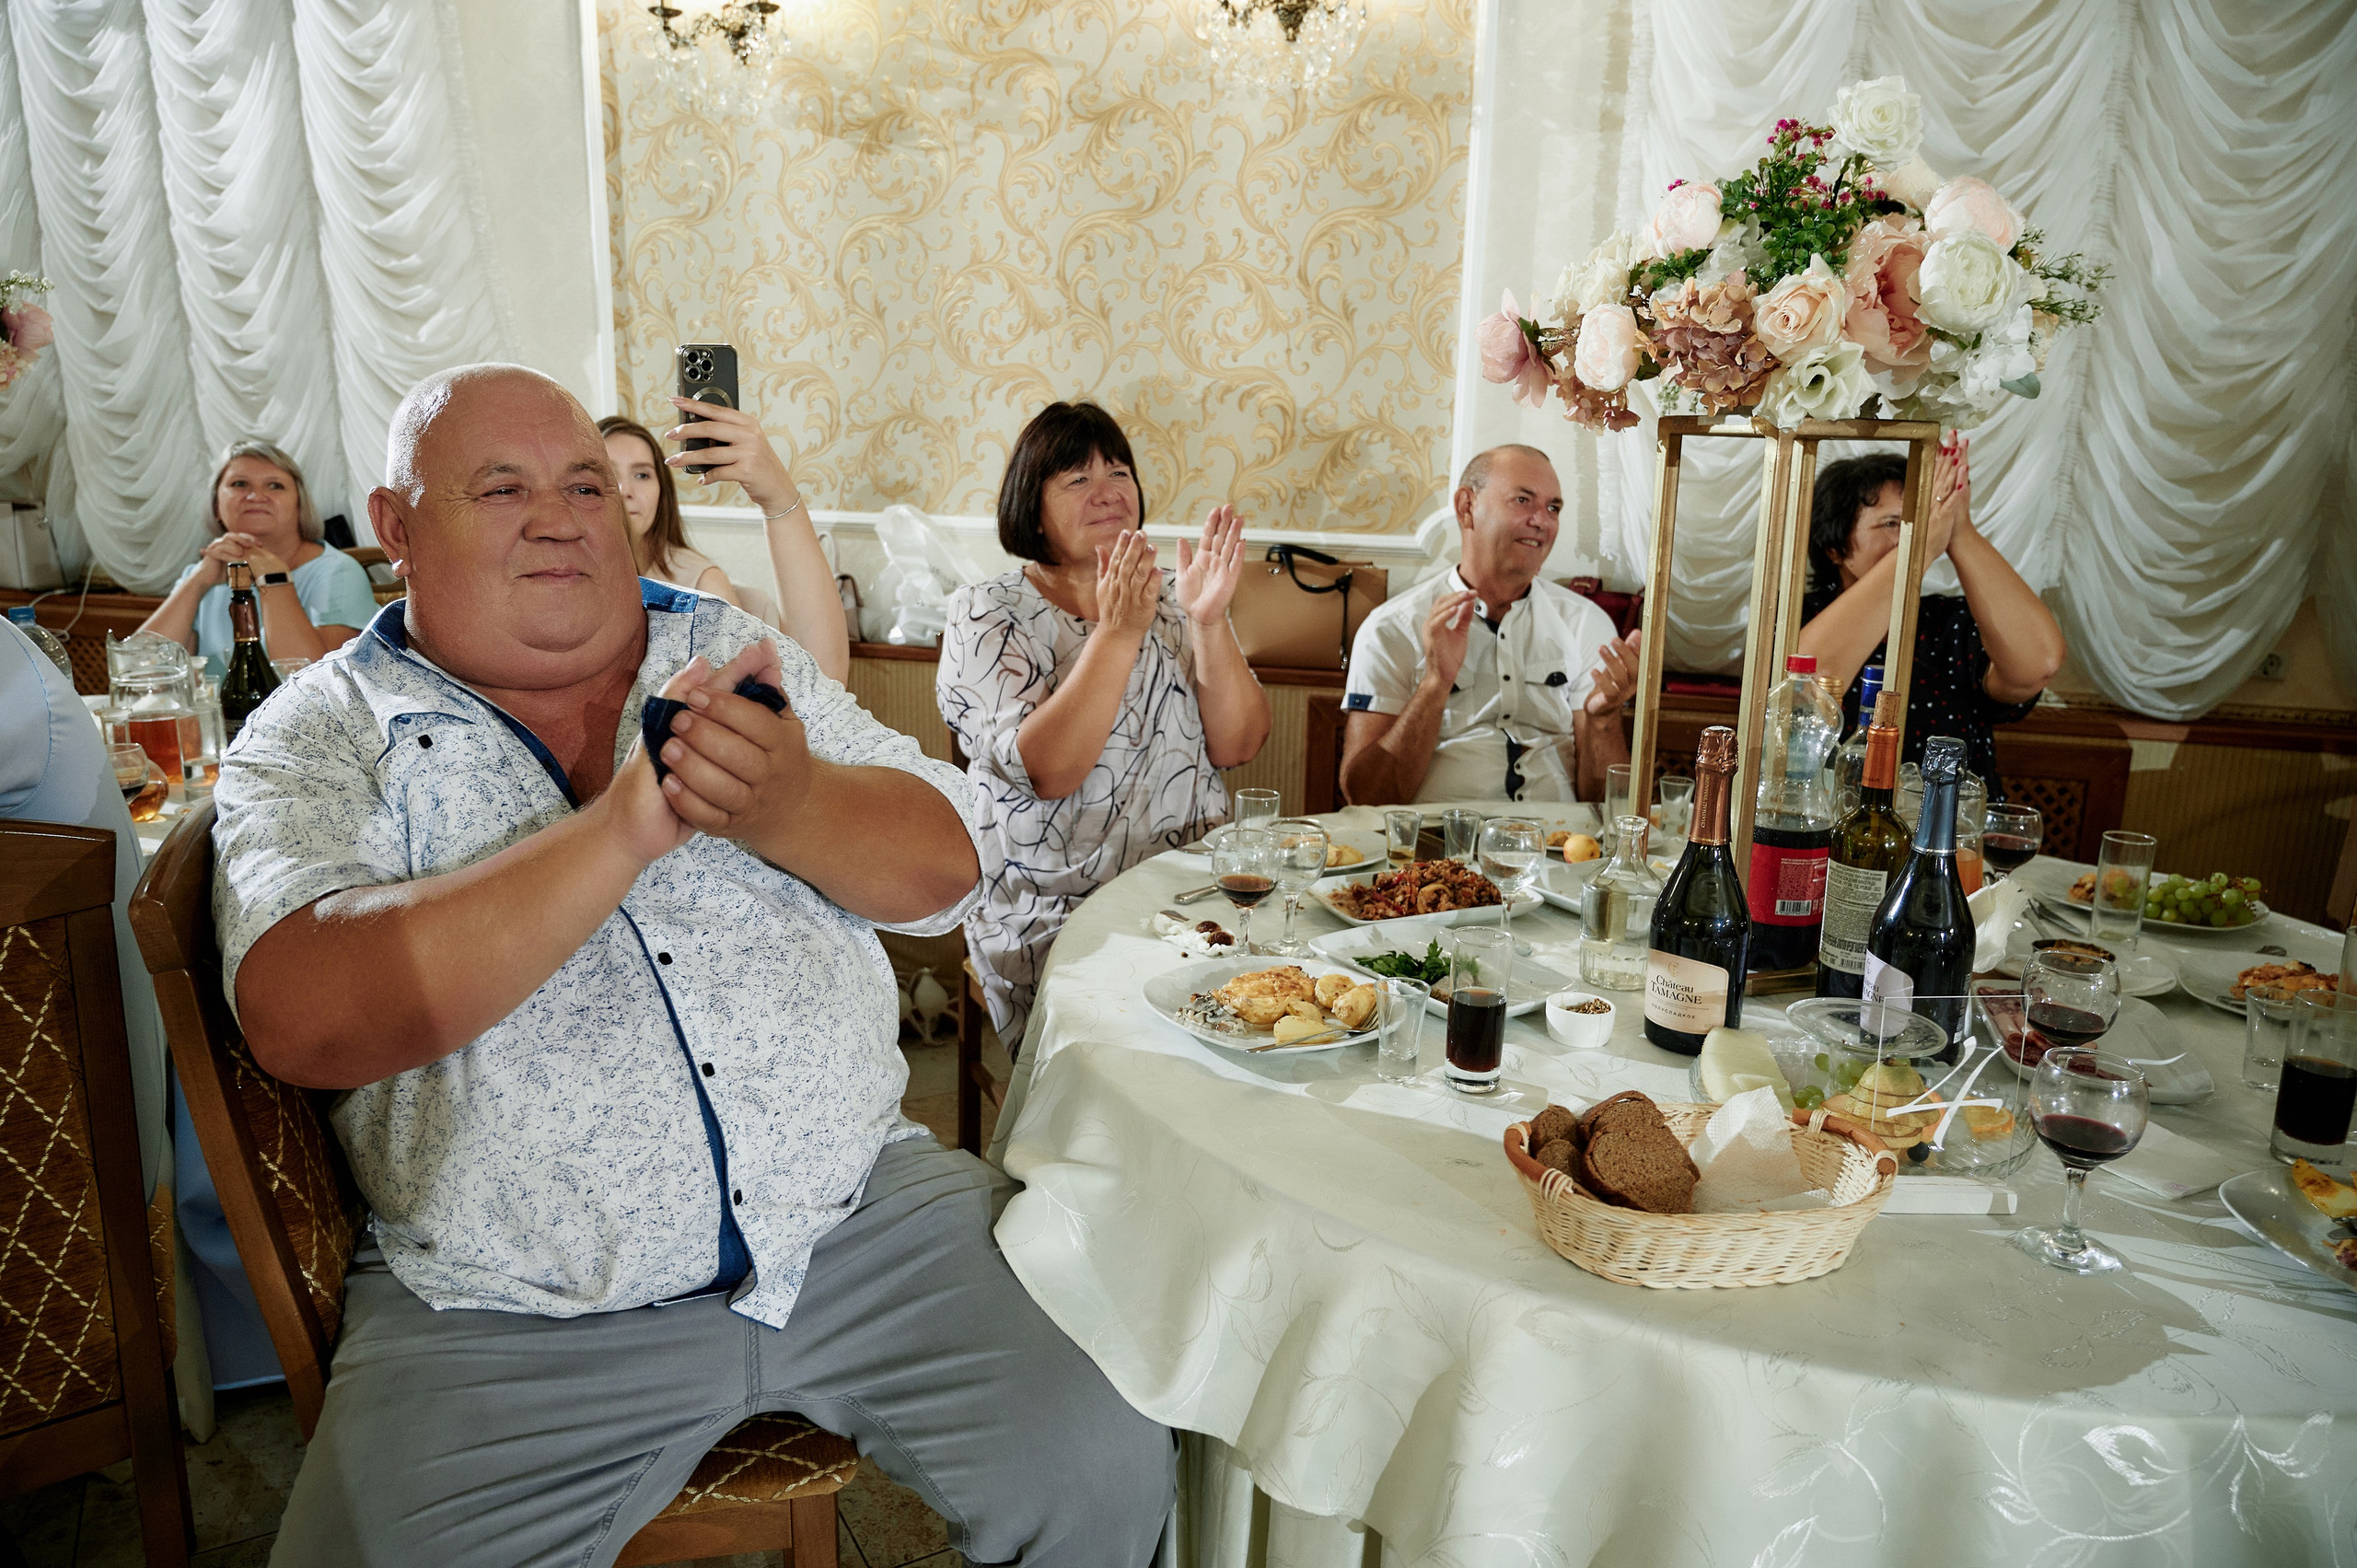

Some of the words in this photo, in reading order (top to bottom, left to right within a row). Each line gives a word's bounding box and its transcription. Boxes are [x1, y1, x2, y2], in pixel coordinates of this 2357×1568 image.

[1651, 980, 1702, 1005] TAMAGNE
[1655, 974, 1694, 993] Château
[1887, 1036, 2003, 1149] 4
